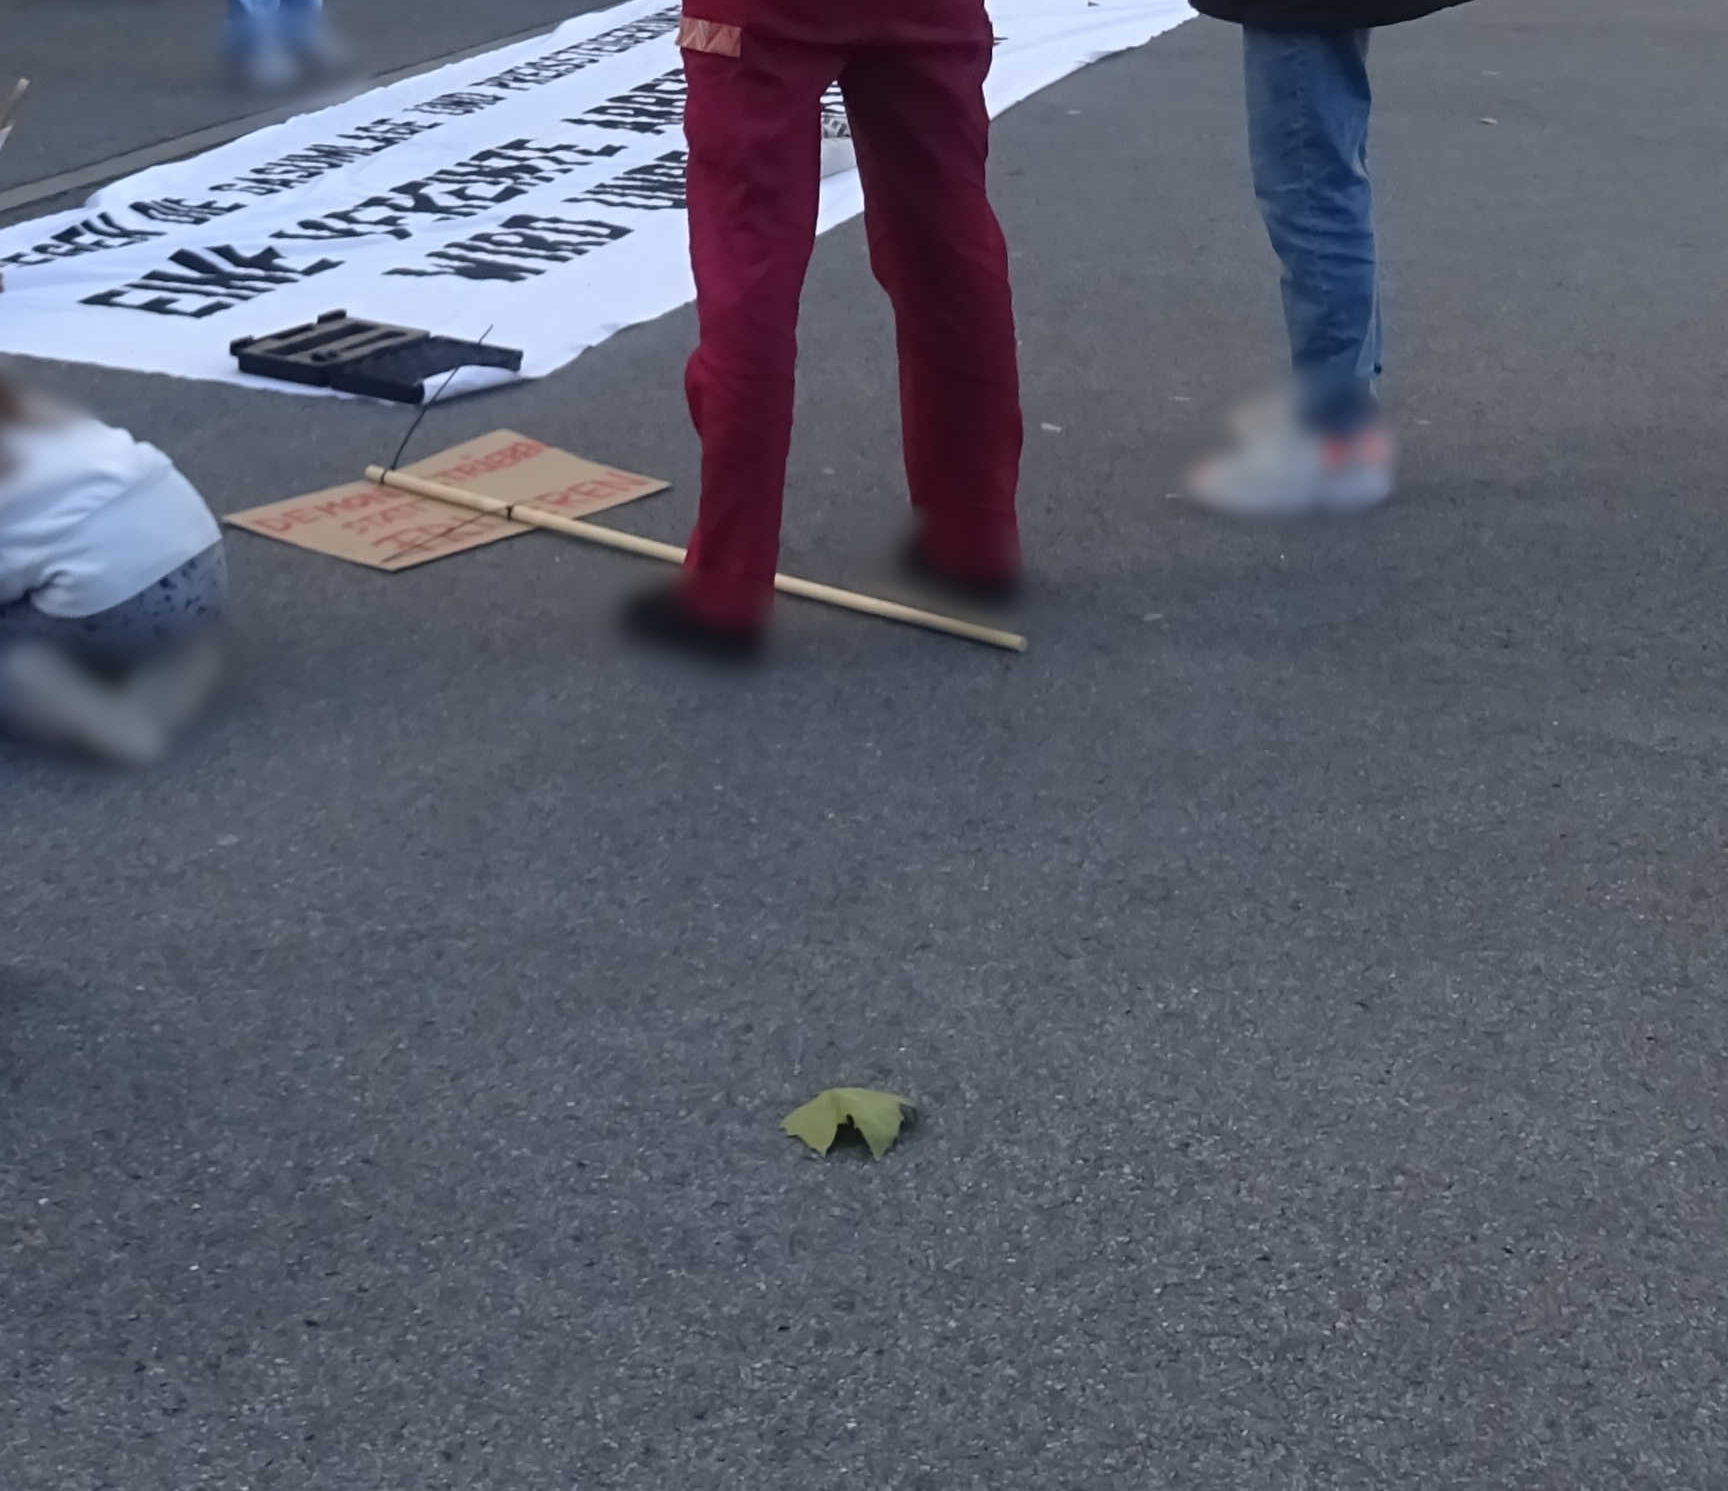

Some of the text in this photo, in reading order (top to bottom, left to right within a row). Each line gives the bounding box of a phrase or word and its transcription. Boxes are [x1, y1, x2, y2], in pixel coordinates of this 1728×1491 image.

[209, 117, 444, 196] GASUMLAGE
[80, 244, 347, 320] EINE
[381, 213, 634, 283] WIRD
